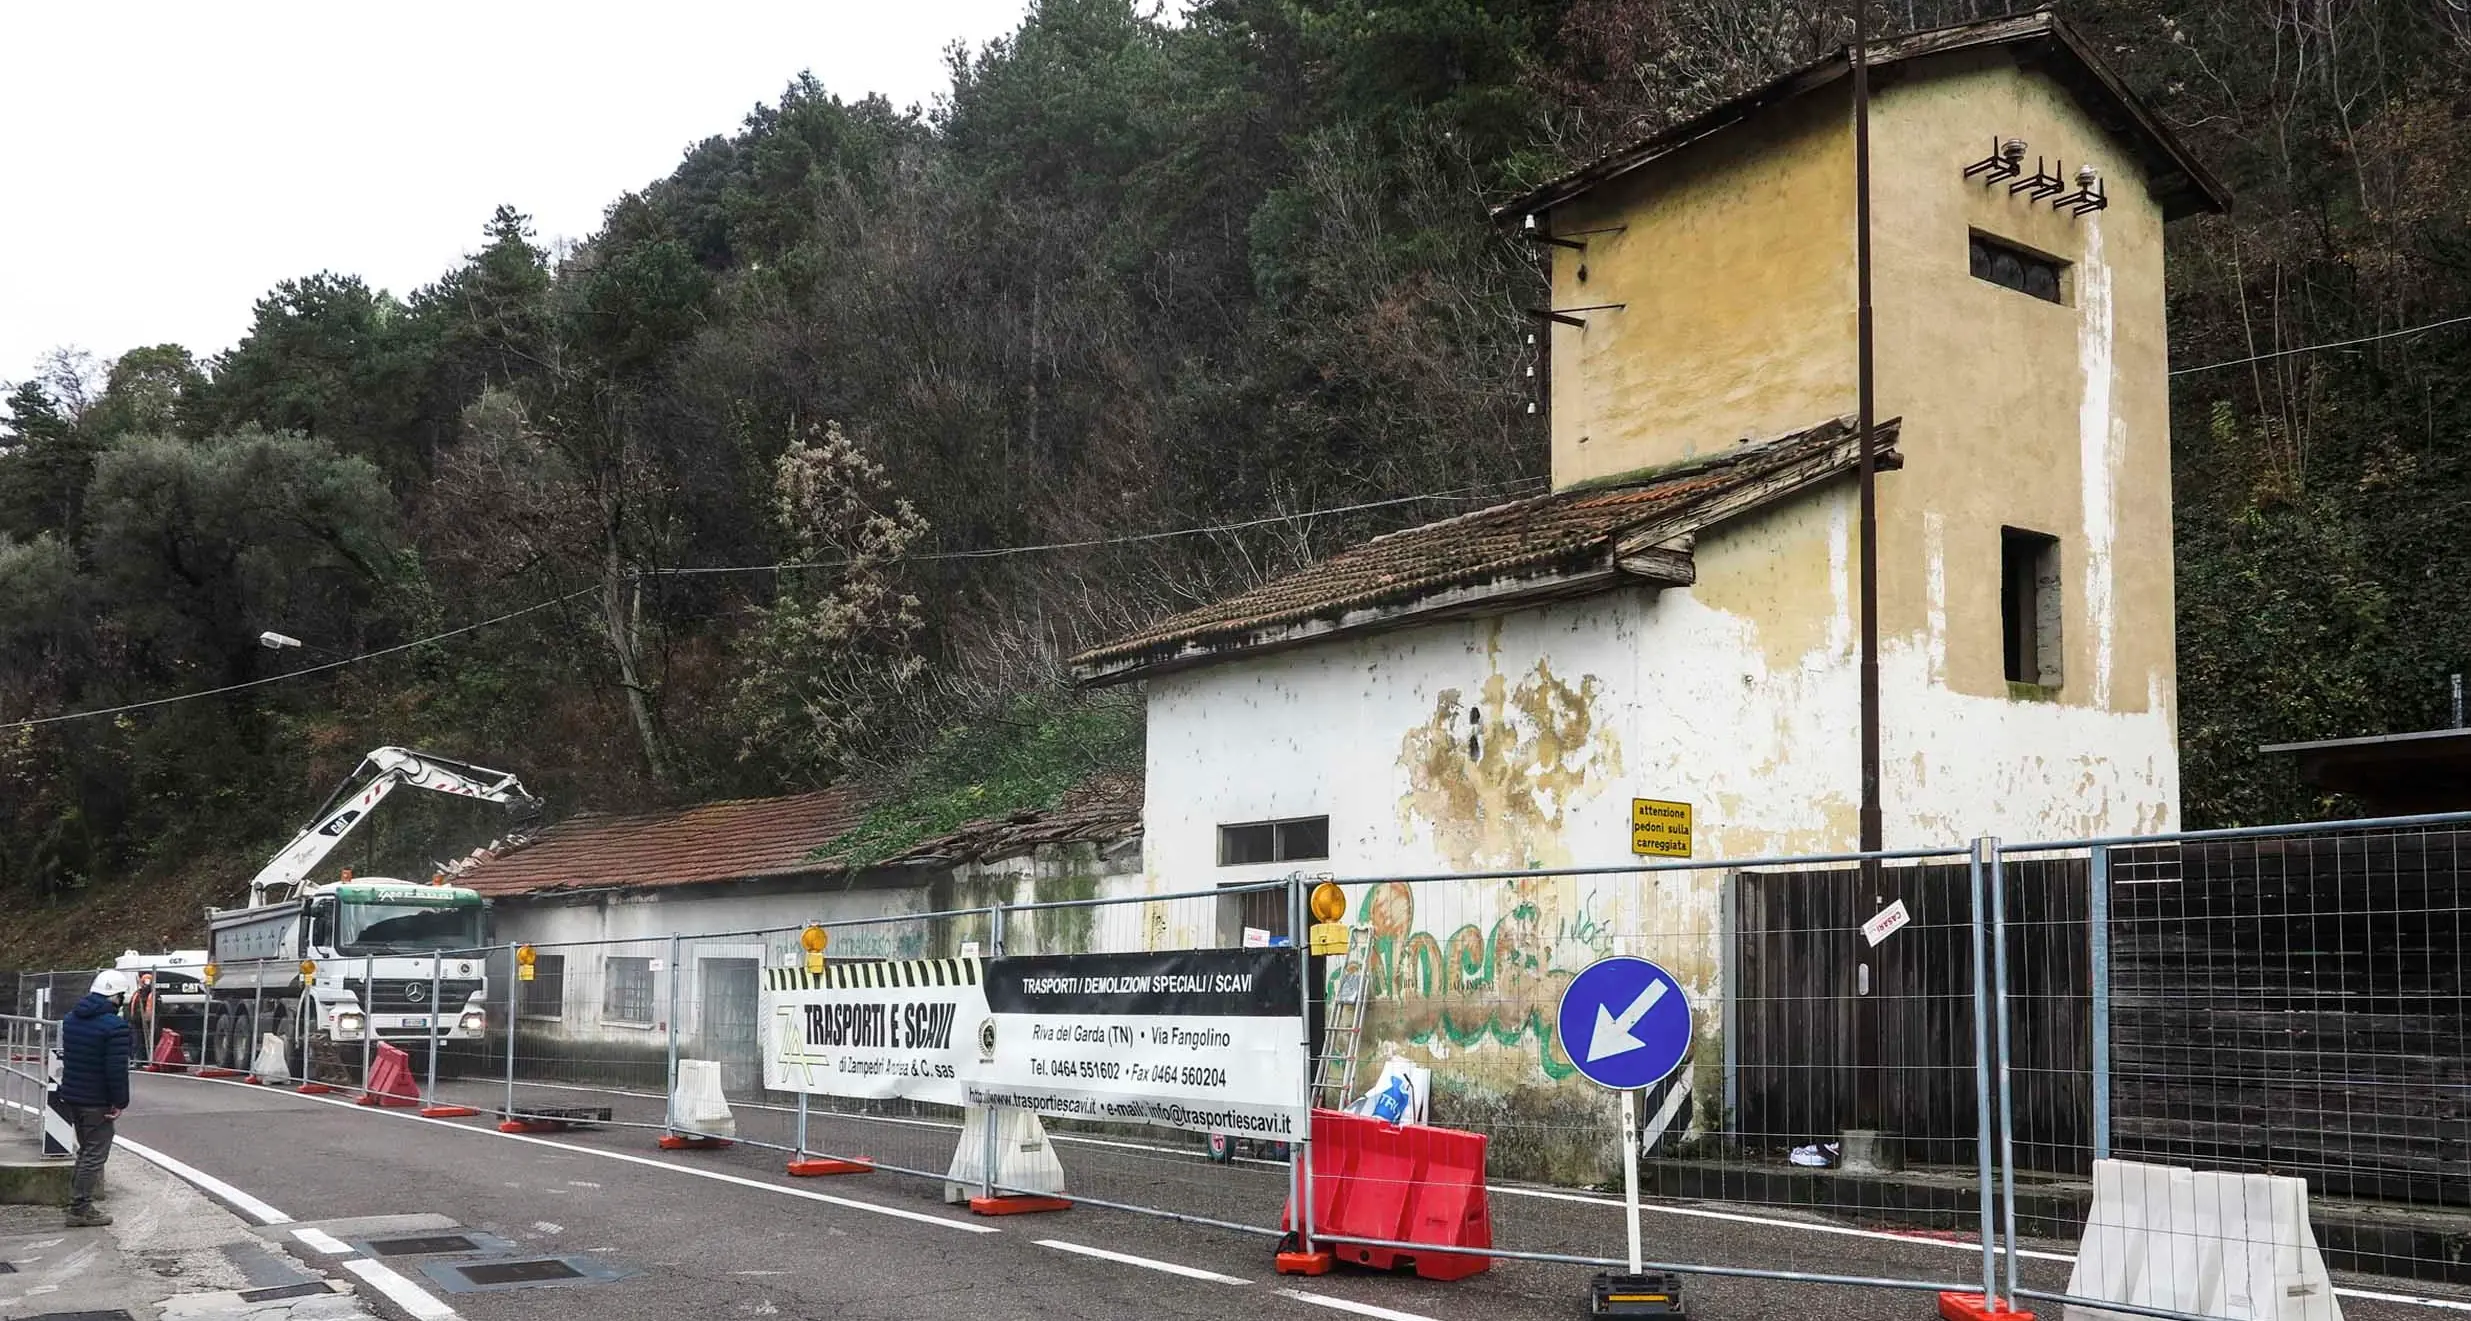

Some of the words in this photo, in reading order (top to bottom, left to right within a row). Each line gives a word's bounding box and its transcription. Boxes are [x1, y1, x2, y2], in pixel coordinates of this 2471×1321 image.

[1639, 805, 1685, 818] attenzione
[330, 816, 349, 834] CAT
[1634, 821, 1664, 832] pedoni
[1668, 824, 1689, 835] sulla
[1637, 838, 1686, 851] carreggiata
[1876, 911, 1902, 933] CASARI
[182, 982, 200, 993] CAT
[1022, 977, 1077, 994] TRASPORTI
[1084, 975, 1151, 994] DEMOLIZIONI
[1152, 974, 1206, 993] SPECIALI
[1215, 973, 1252, 993] SCAVI
[804, 1003, 886, 1048] TRASPORTI
[891, 1003, 900, 1048] E
[904, 1002, 957, 1050] SCAVI
[1033, 1024, 1053, 1041] Riva
[1056, 1024, 1072, 1041] del
[1074, 1024, 1105, 1043] Garda
[1108, 1025, 1134, 1048] (TN)
[1152, 1026, 1168, 1044] Via
[1171, 1027, 1231, 1050] Fangolino
[839, 1057, 847, 1073] di
[847, 1056, 884, 1079] Zampedri
[911, 1060, 919, 1077] &
[920, 1059, 934, 1078] C.
[935, 1062, 956, 1079] sas
[1031, 1058, 1048, 1076] Tel.
[1050, 1059, 1077, 1077] 0464
[1080, 1061, 1120, 1080] 551602
[1130, 1063, 1149, 1082] Fax
[1151, 1064, 1178, 1084] 0464
[1181, 1067, 1226, 1087] 560204
[1107, 1100, 1145, 1118] e-mail:
[1148, 1103, 1292, 1134] info@trasportiescavi.it
